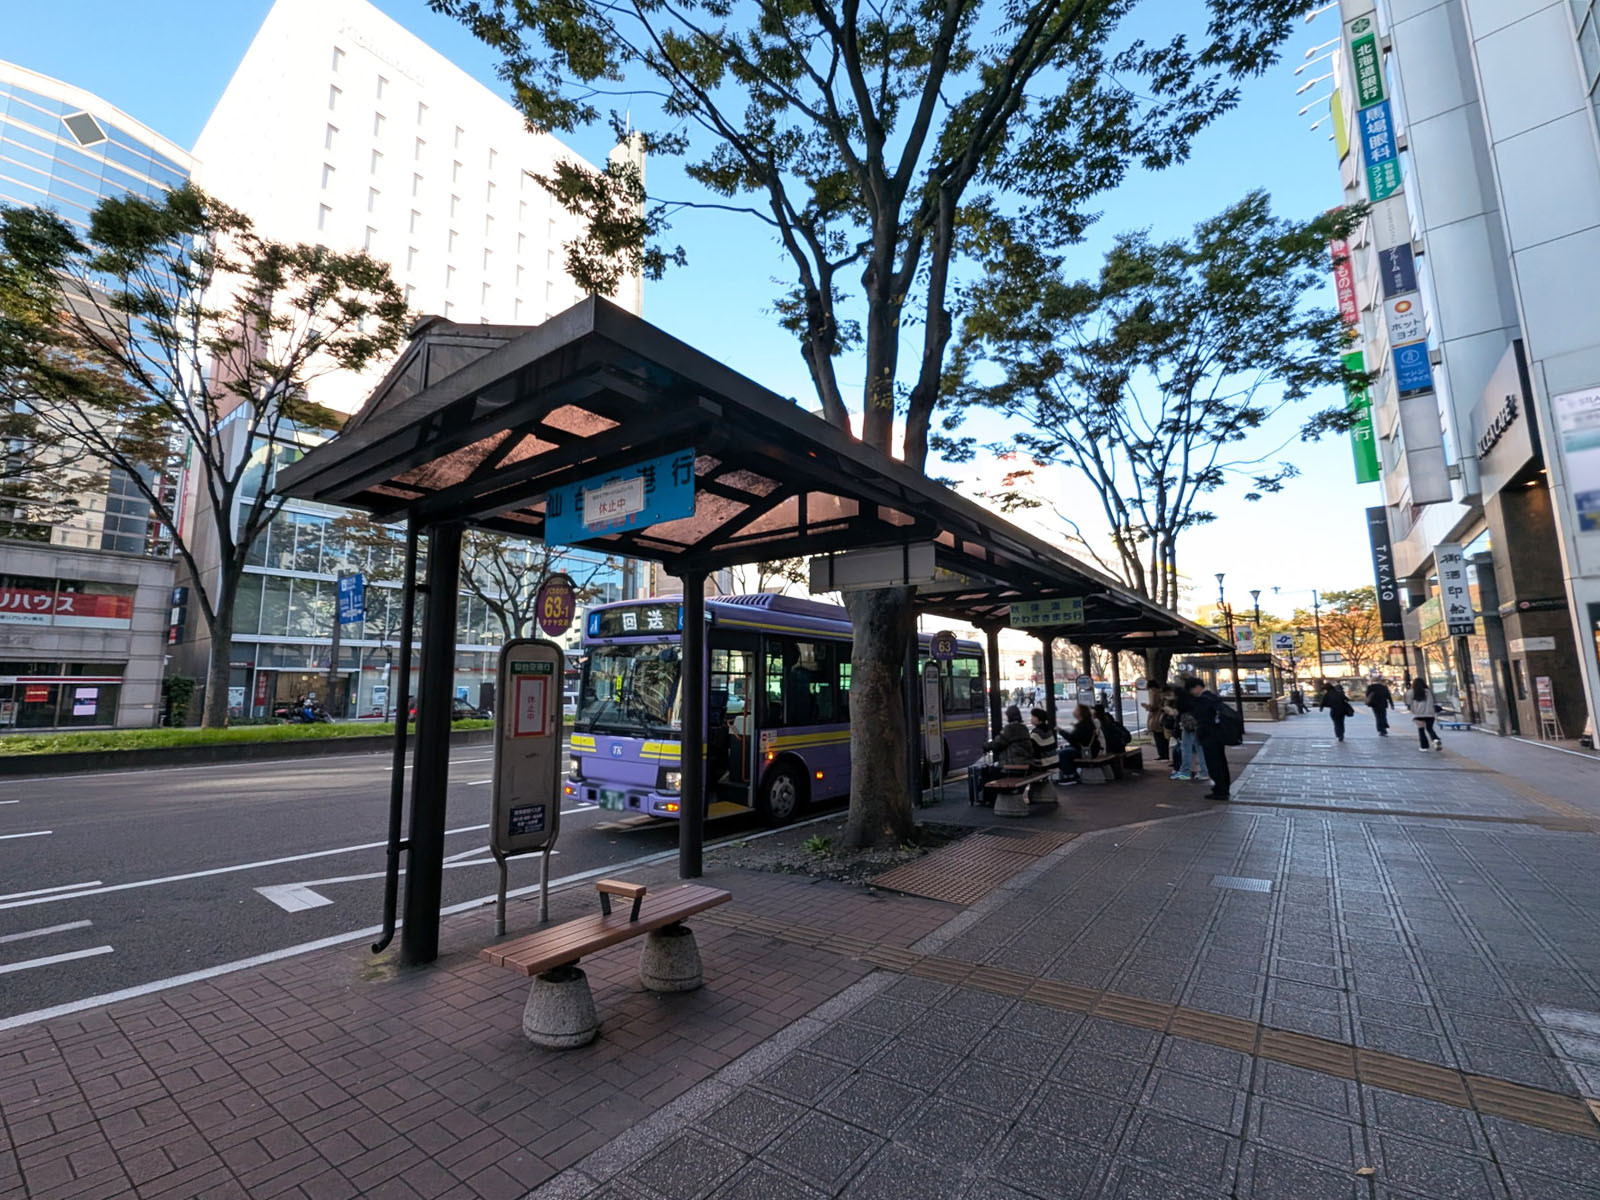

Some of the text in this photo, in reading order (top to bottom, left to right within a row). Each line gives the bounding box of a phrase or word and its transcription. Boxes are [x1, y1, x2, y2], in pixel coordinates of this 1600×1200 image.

[1357, 44, 1378, 100] 北海道銀行
[1365, 105, 1391, 162] 馬場眼科
[1391, 318, 1421, 331] ホット
[1396, 327, 1418, 340] ヨガ
[598, 498, 626, 515] 休止中
[544, 596, 569, 618] 63-1
[622, 610, 665, 631] 回送
[938, 640, 951, 652] 63
